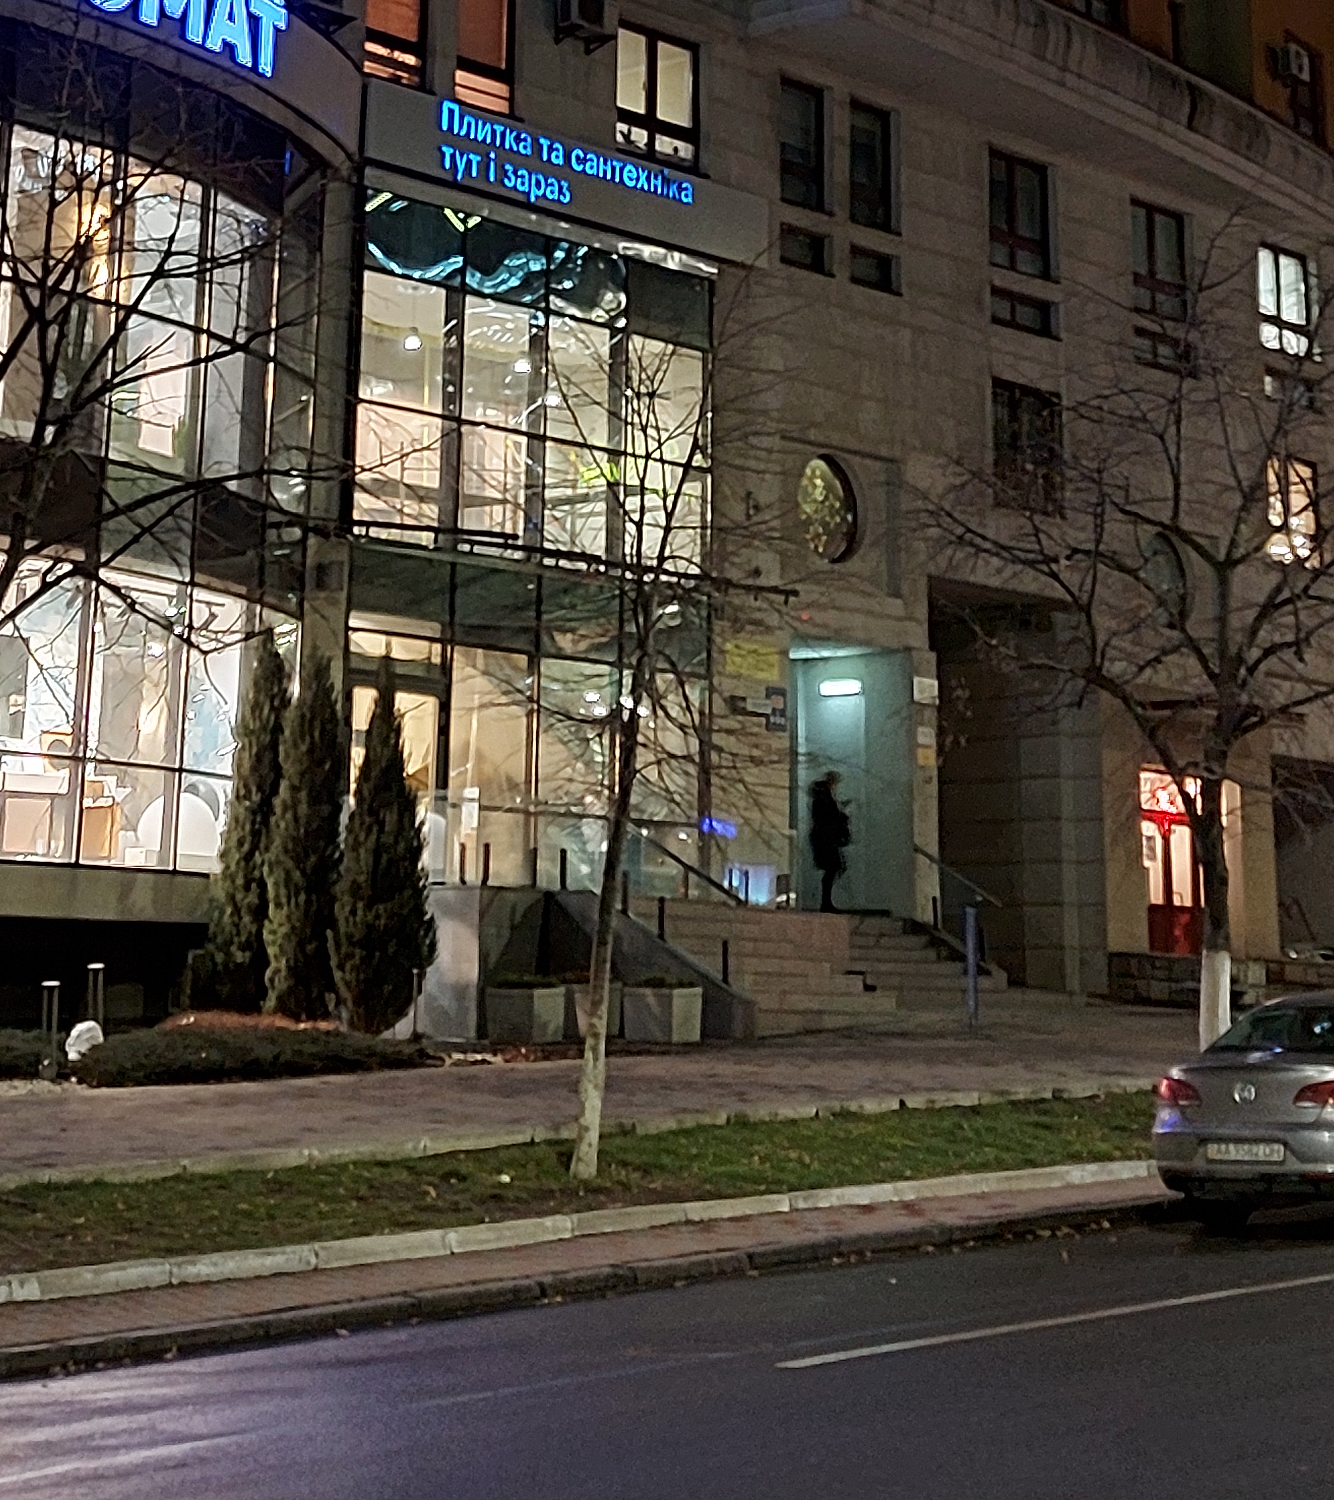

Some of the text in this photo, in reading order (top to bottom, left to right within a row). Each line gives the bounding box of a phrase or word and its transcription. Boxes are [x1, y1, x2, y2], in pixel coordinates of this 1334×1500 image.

[440, 100, 694, 205] Плитка та сантехніка
[441, 143, 572, 204] тут і зараз
